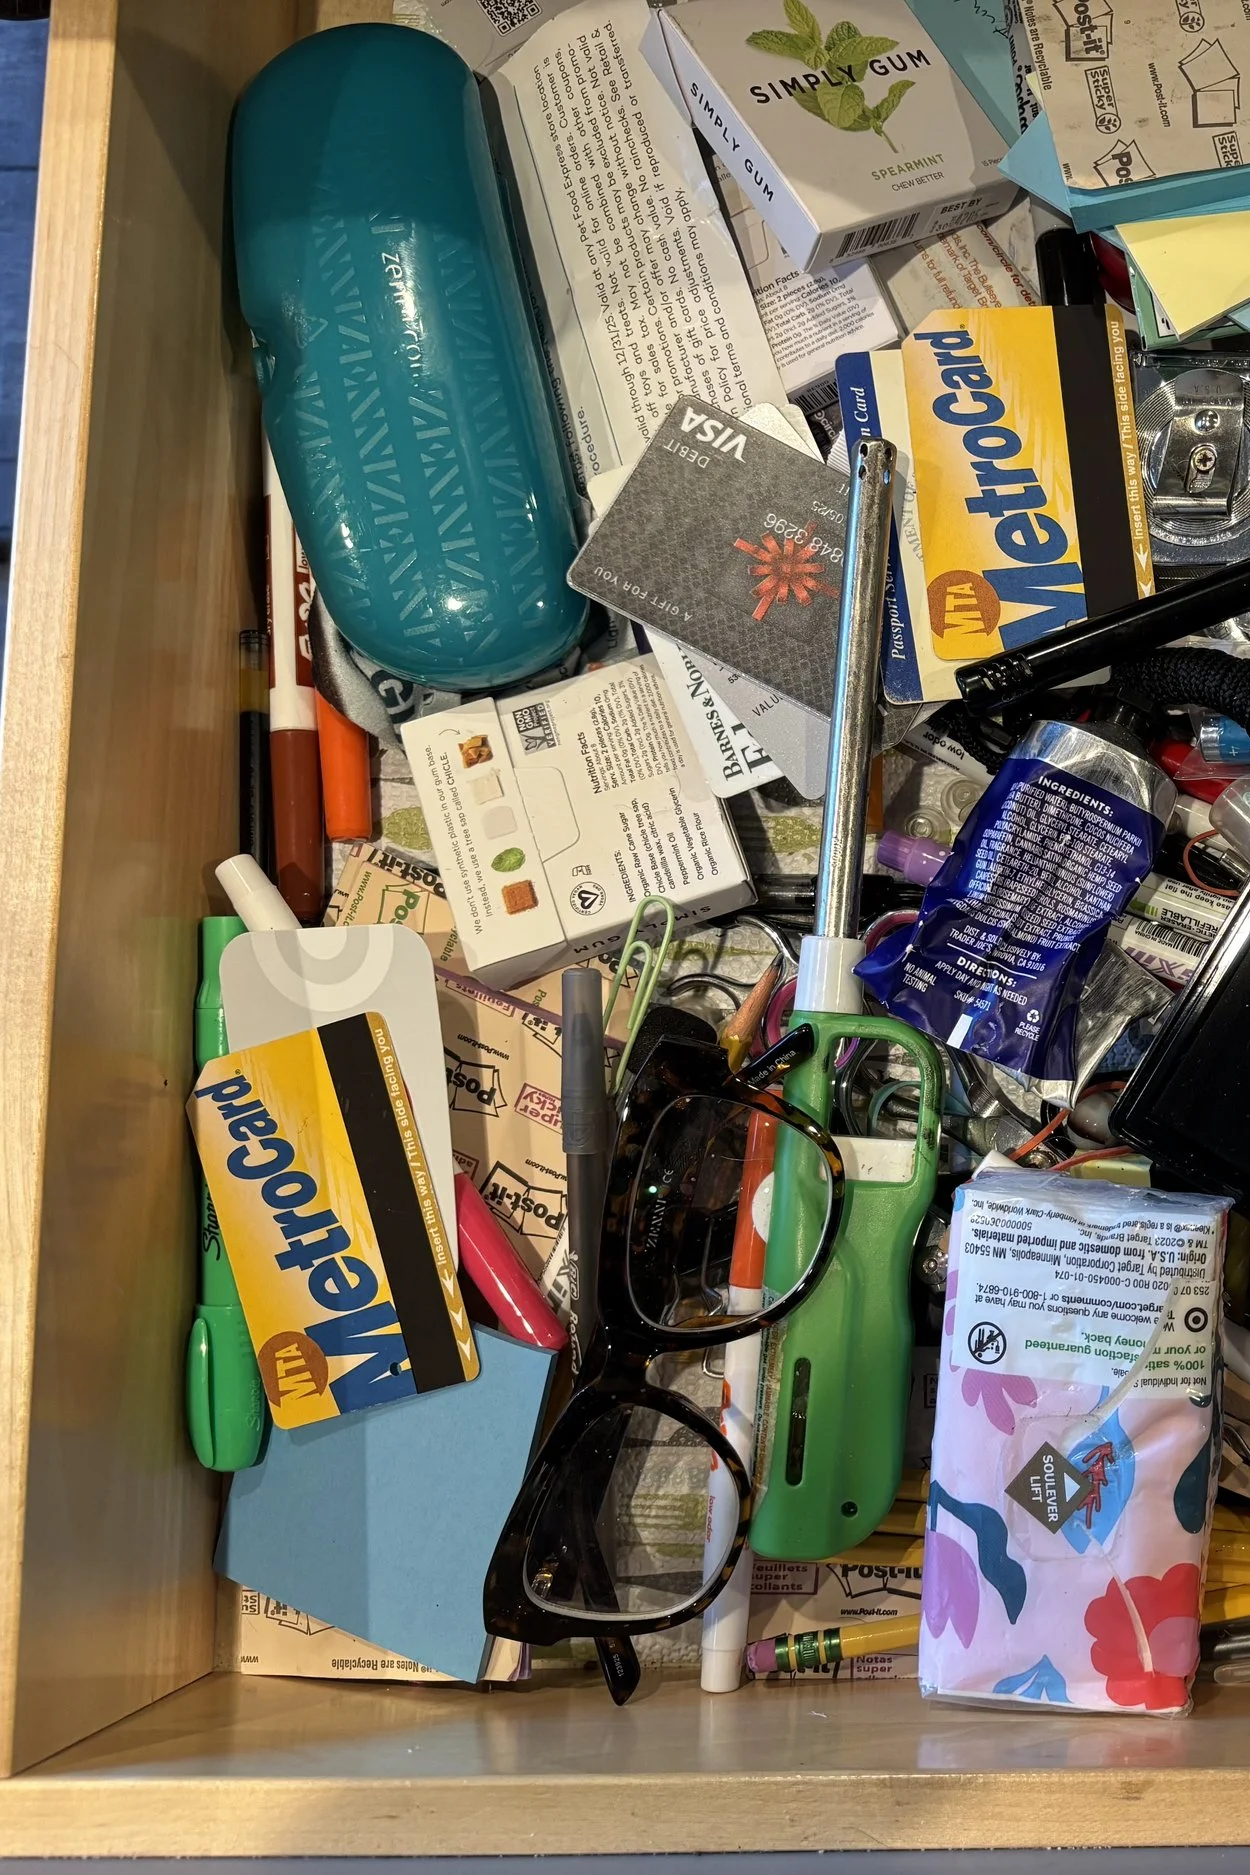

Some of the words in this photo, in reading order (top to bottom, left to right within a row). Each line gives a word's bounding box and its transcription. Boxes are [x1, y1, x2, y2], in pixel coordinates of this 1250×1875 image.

[1023, 5, 1040, 27] Notes
[1029, 27, 1040, 42] are
[749, 63, 858, 105] SIMPLY
[867, 46, 932, 78] GUM
[1032, 42, 1052, 90] Recyclable
[533, 64, 555, 112] location
[545, 112, 561, 142] store
[690, 82, 740, 151] SIMPLY
[744, 158, 773, 202] GUM
[554, 143, 572, 189] Express
[871, 153, 944, 180] SPEARMINT
[566, 189, 582, 220] Food
[576, 220, 589, 242] Pet
[584, 244, 597, 265] any
[591, 266, 602, 280] at
[594, 282, 610, 313] Valid
[604, 312, 627, 365] 12/31/25.
[620, 366, 641, 413] through
[849, 386, 868, 422] Card
[634, 414, 655, 446] valid
[676, 405, 748, 463] VISA
[662, 438, 710, 468] DEBIT
[760, 512, 807, 544] 3296
[593, 566, 623, 587] YOU
[622, 580, 648, 599] FOR
[649, 593, 679, 615] GIFT
[679, 610, 692, 623] A
[943, 581, 987, 636] MTA
[881, 595, 905, 659] Passport
[514, 709, 528, 730] NON
[520, 707, 536, 728] GMO
[535, 701, 556, 745] VERIFIED
[577, 731, 591, 755] Facts
[705, 708, 744, 781] BARNES
[584, 755, 602, 794] Nutrition
[1037, 774, 1114, 817] INGREDIENTS:
[613, 849, 636, 902] INGREDIENTS:
[370, 1028, 391, 1053] you
[382, 1056, 401, 1100] facing
[747, 1069, 768, 1087] Made
[774, 1050, 796, 1067] China
[392, 1099, 408, 1129] side
[400, 1130, 417, 1160] This
[411, 1170, 432, 1200] way
[419, 1199, 436, 1224] this
[428, 1226, 446, 1265] Insert
[971, 1227, 1014, 1243] materials.
[1016, 1234, 1057, 1250] imported
[1058, 1239, 1076, 1251] and
[1078, 1240, 1121, 1257] domestic
[1123, 1246, 1145, 1260] from
[1147, 1249, 1174, 1263] U.S.A.
[1177, 1249, 1206, 1264] Origin:
[976, 1282, 1046, 1302] 1-800-910-6874.
[1049, 1293, 1059, 1301] or
[1024, 1339, 1091, 1354] guaranteed
[1080, 1331, 1111, 1346] back.
[274, 1341, 319, 1405] MTA
[1029, 1475, 1042, 1503] LIFT
[1042, 1454, 1058, 1522] SOULEVER
